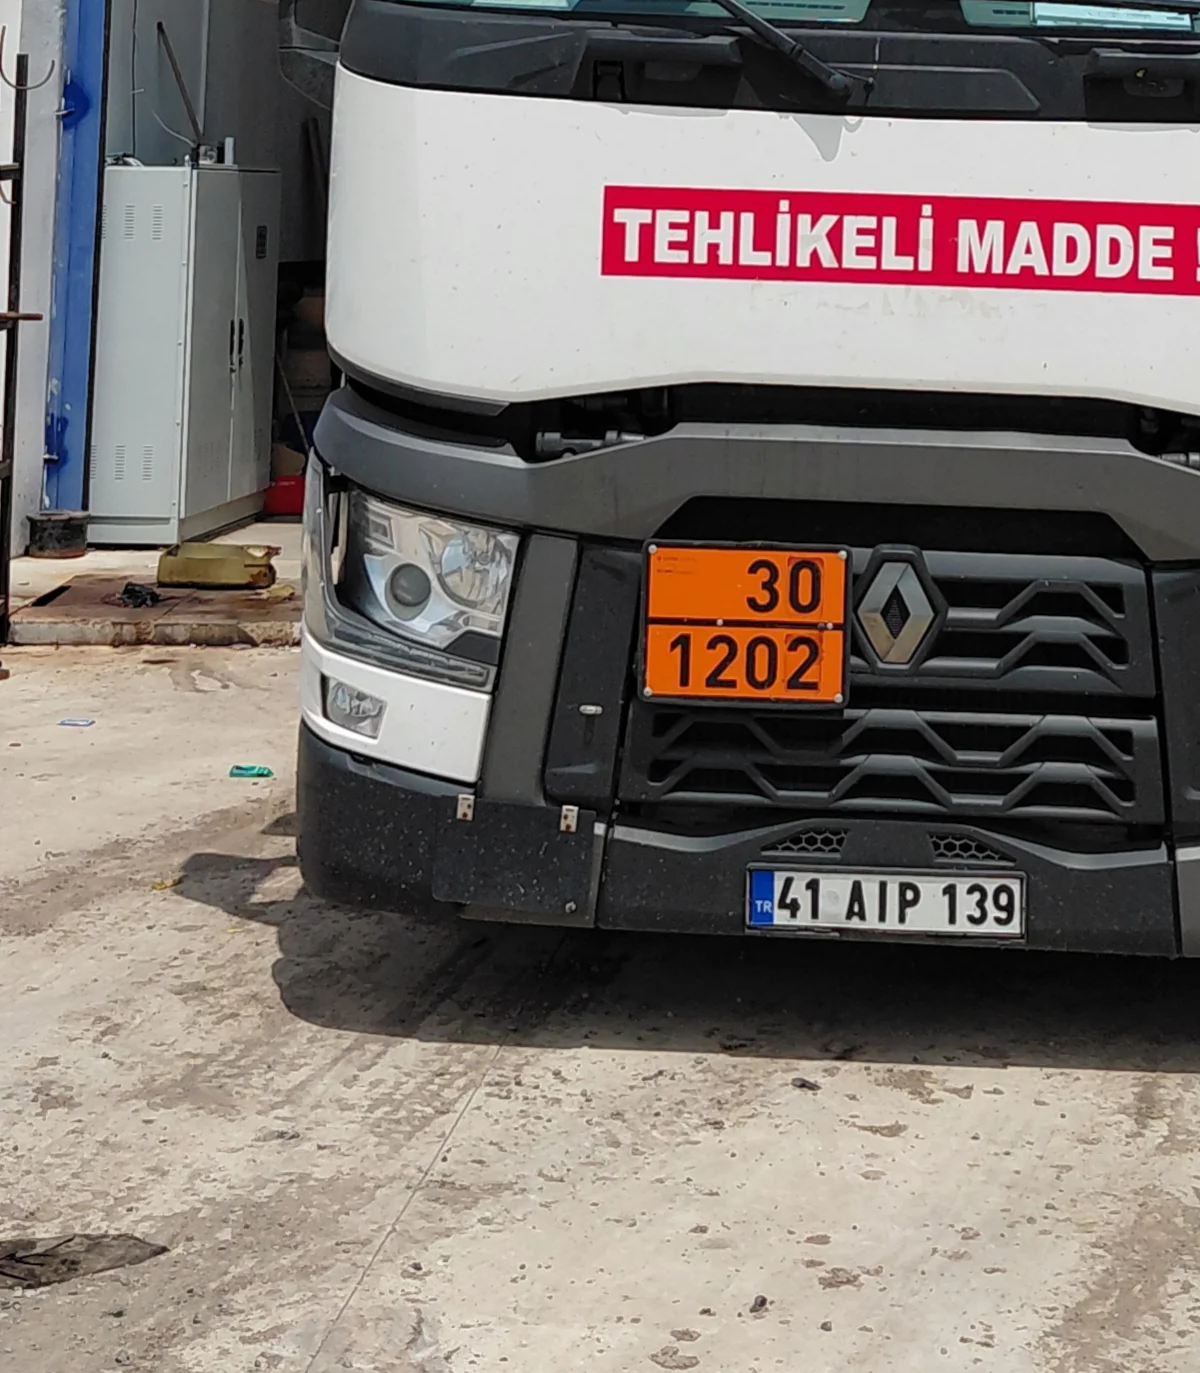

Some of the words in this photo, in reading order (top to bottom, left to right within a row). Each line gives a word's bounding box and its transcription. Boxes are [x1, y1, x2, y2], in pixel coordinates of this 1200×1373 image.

[613, 200, 933, 272] TEHLİKELİ
[957, 219, 1174, 281] MADDE
[746, 559, 822, 613] 30
[670, 633, 820, 691] 1202
[755, 900, 773, 914] TR
[777, 876, 821, 920] 41
[845, 879, 921, 924] AIP
[942, 883, 1015, 926] 139
